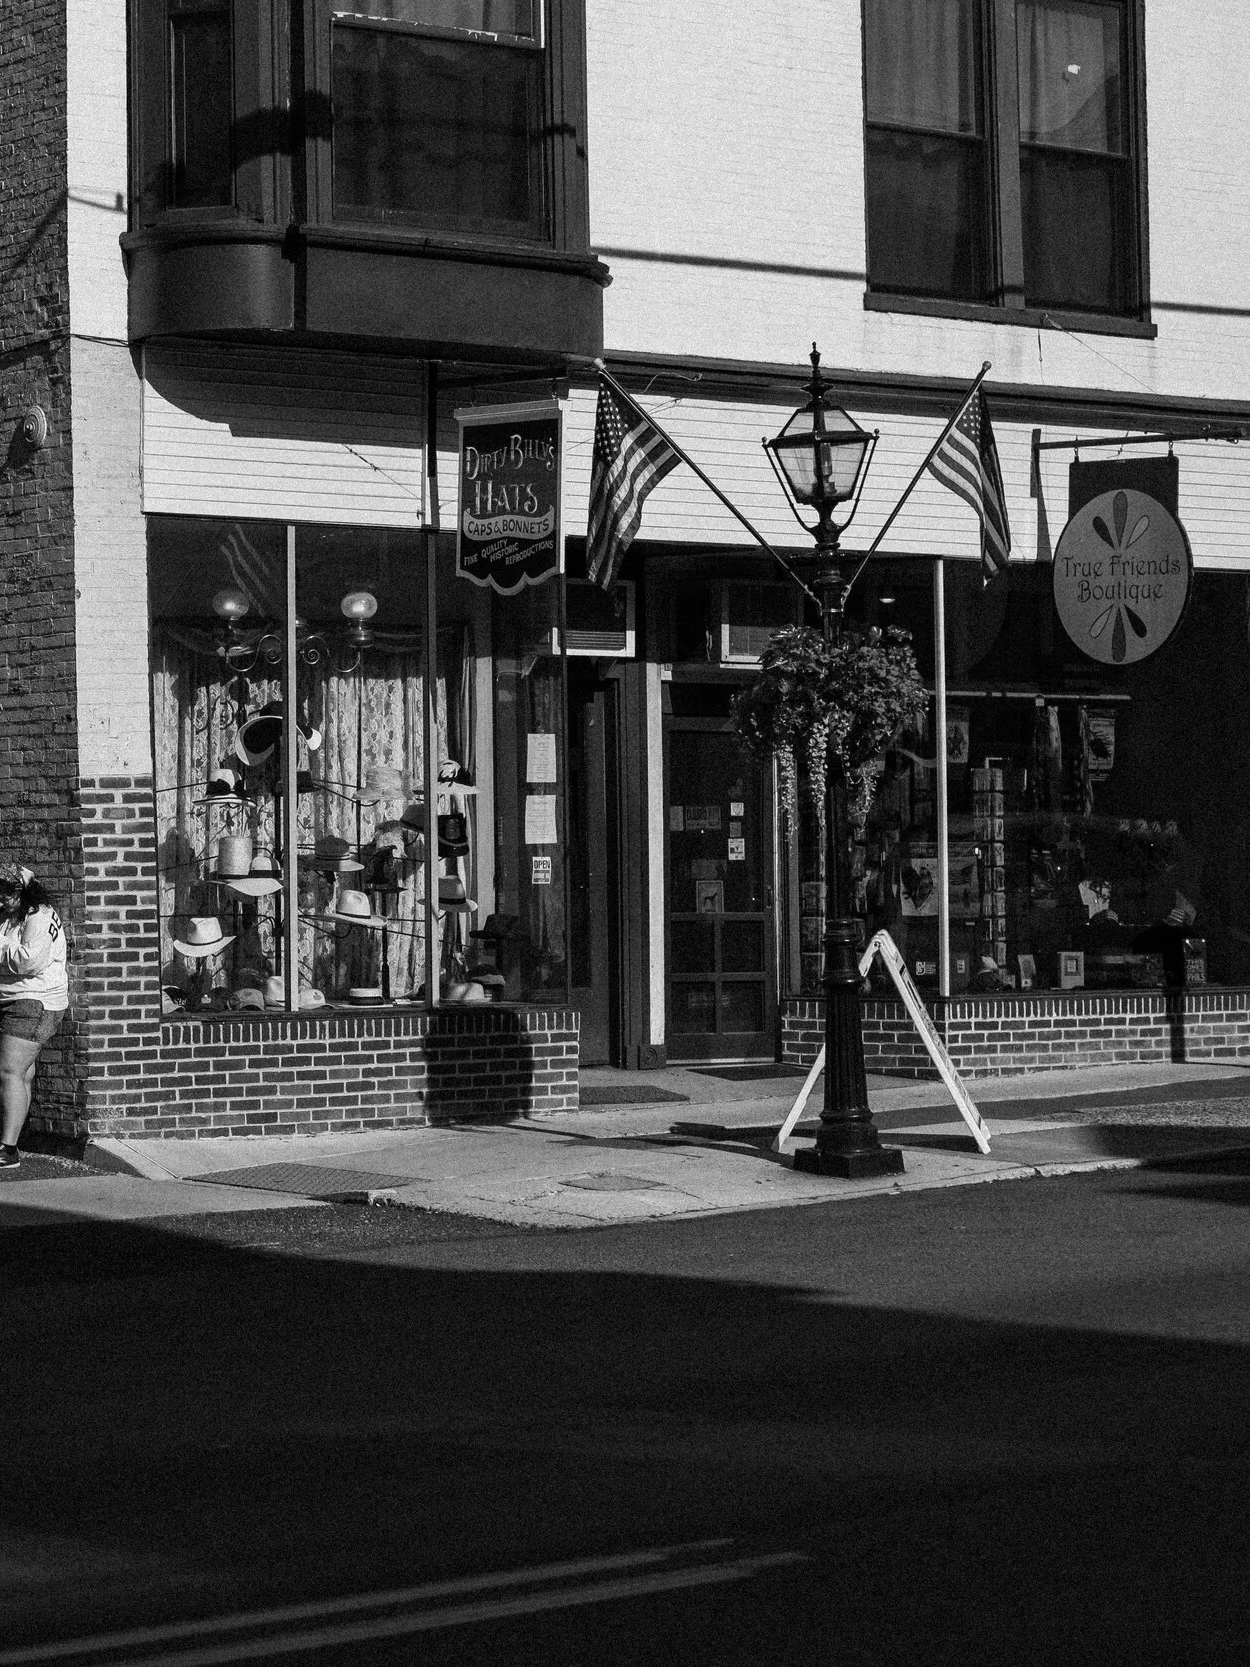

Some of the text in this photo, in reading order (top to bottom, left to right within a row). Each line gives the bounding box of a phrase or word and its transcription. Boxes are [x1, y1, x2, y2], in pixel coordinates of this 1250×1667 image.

[474, 480, 538, 515] HATS
[467, 518, 550, 536] CAPS & BONNETS
[481, 539, 508, 558] QUALITY
[490, 542, 519, 562] HISTORIC
[505, 540, 554, 565] REPRODUCTIONS
[1061, 553, 1181, 579] True Friends
[1077, 579, 1164, 604] Boutique
[534, 860, 550, 870] OPEN
